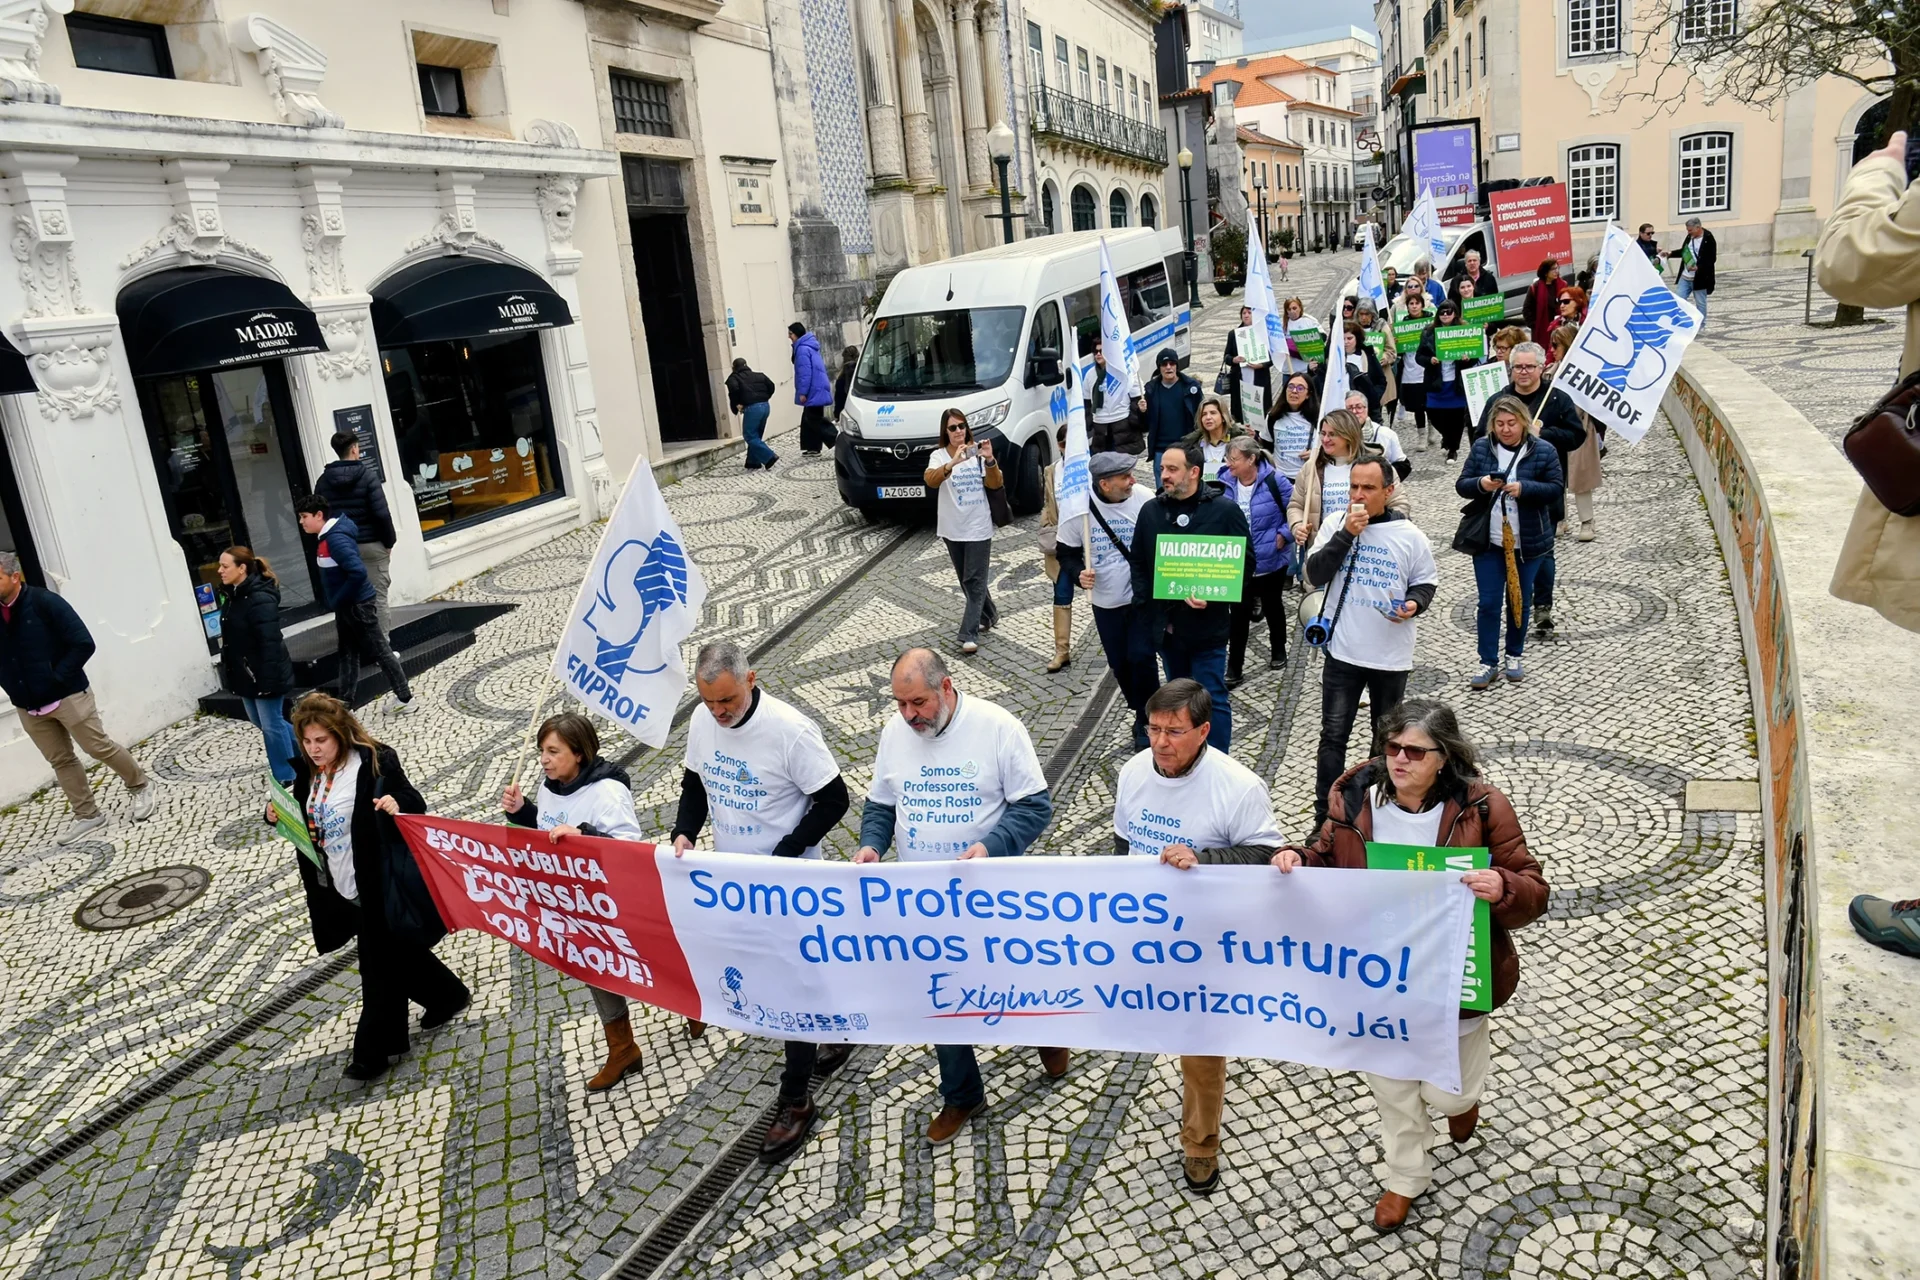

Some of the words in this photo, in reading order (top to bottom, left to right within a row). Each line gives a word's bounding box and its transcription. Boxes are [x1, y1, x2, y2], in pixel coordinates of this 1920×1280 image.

[1420, 172, 1456, 184] Imersão
[1458, 172, 1470, 180] na
[1496, 202, 1517, 212] SOMOS
[1517, 197, 1552, 208] PROFESSORES
[1499, 223, 1519, 232] DAMOS
[1519, 220, 1538, 230] ROSTO
[1538, 218, 1546, 226] AO
[1546, 214, 1566, 224] FUTURO!
[498, 302, 539, 318] MADRE
[1463, 295, 1503, 309] VALORIZAÇÃO
[235, 321, 298, 343] MADRE
[1437, 328, 1481, 340] VALORIZAÇÃO
[1558, 362, 1642, 426] FENPROF
[1106, 518, 1128, 526] omos
[1096, 544, 1108, 552] ao
[1160, 541, 1242, 562] VALORIZAÇÃO
[1353, 542, 1388, 556] Somos
[1372, 566, 1399, 581] Rosto
[714, 750, 748, 768] Somos
[920, 765, 960, 778] Somos
[734, 784, 768, 798] Rosto
[904, 780, 980, 792] Professores.
[718, 794, 758, 811] Futuro!
[902, 796, 942, 808] Damos
[945, 796, 982, 808] Rosto
[908, 812, 924, 822] ao
[926, 810, 974, 824] Futuro!
[1140, 808, 1182, 828] Somos
[1128, 821, 1198, 849] Professores.
[1127, 834, 1160, 856] Damos
[424, 826, 509, 866] ESCOLA
[506, 843, 610, 884] PÚBLICA
[689, 870, 845, 918] Somos
[859, 876, 1185, 932] Professores,
[538, 925, 654, 988] ATAQUE!
[799, 924, 968, 963] damos
[984, 933, 1116, 966] rosto
[1132, 940, 1203, 965] ao
[1218, 930, 1412, 994] futuro!
[726, 1007, 750, 1020] FENPROF
[928, 971, 1084, 1026] Exigimos
[1094, 983, 1337, 1037] Valorização,
[1348, 1010, 1410, 1042] Já!
